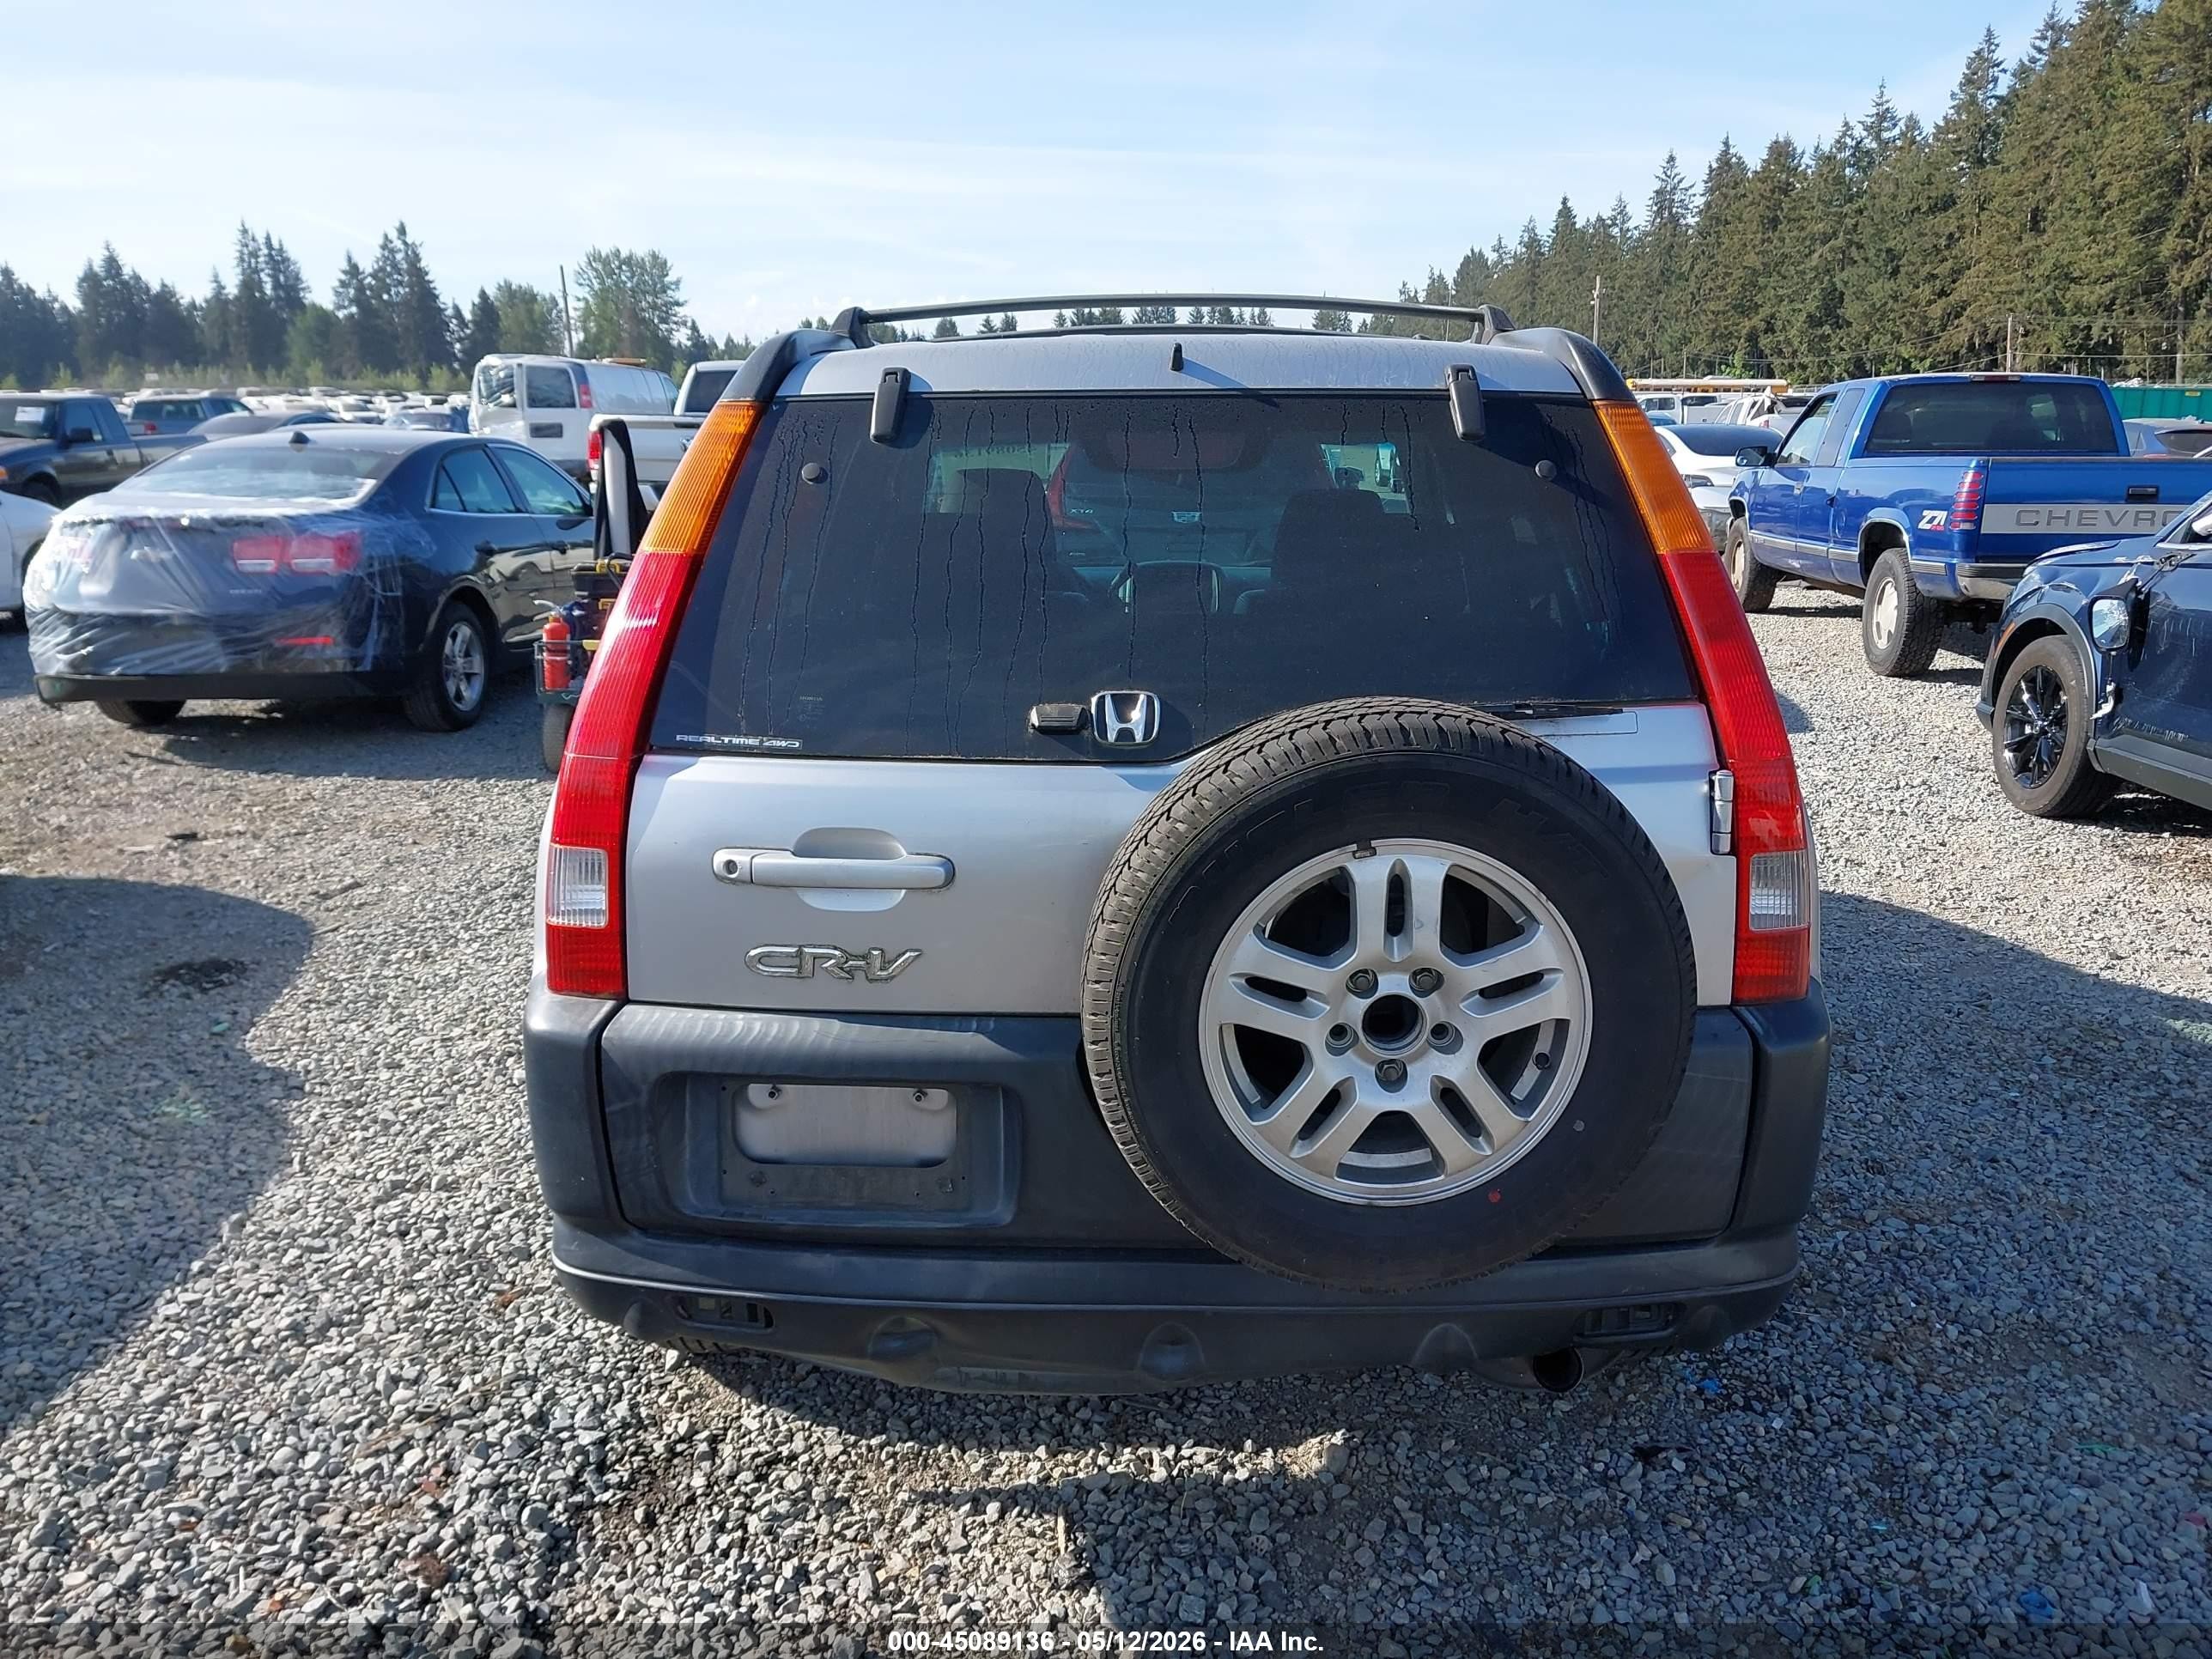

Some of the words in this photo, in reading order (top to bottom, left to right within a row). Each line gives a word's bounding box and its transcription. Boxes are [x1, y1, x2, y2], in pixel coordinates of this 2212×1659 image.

[1917, 510, 1948, 529] Z71
[676, 734, 760, 745] REALTIME
[744, 944, 924, 982] CR-V
